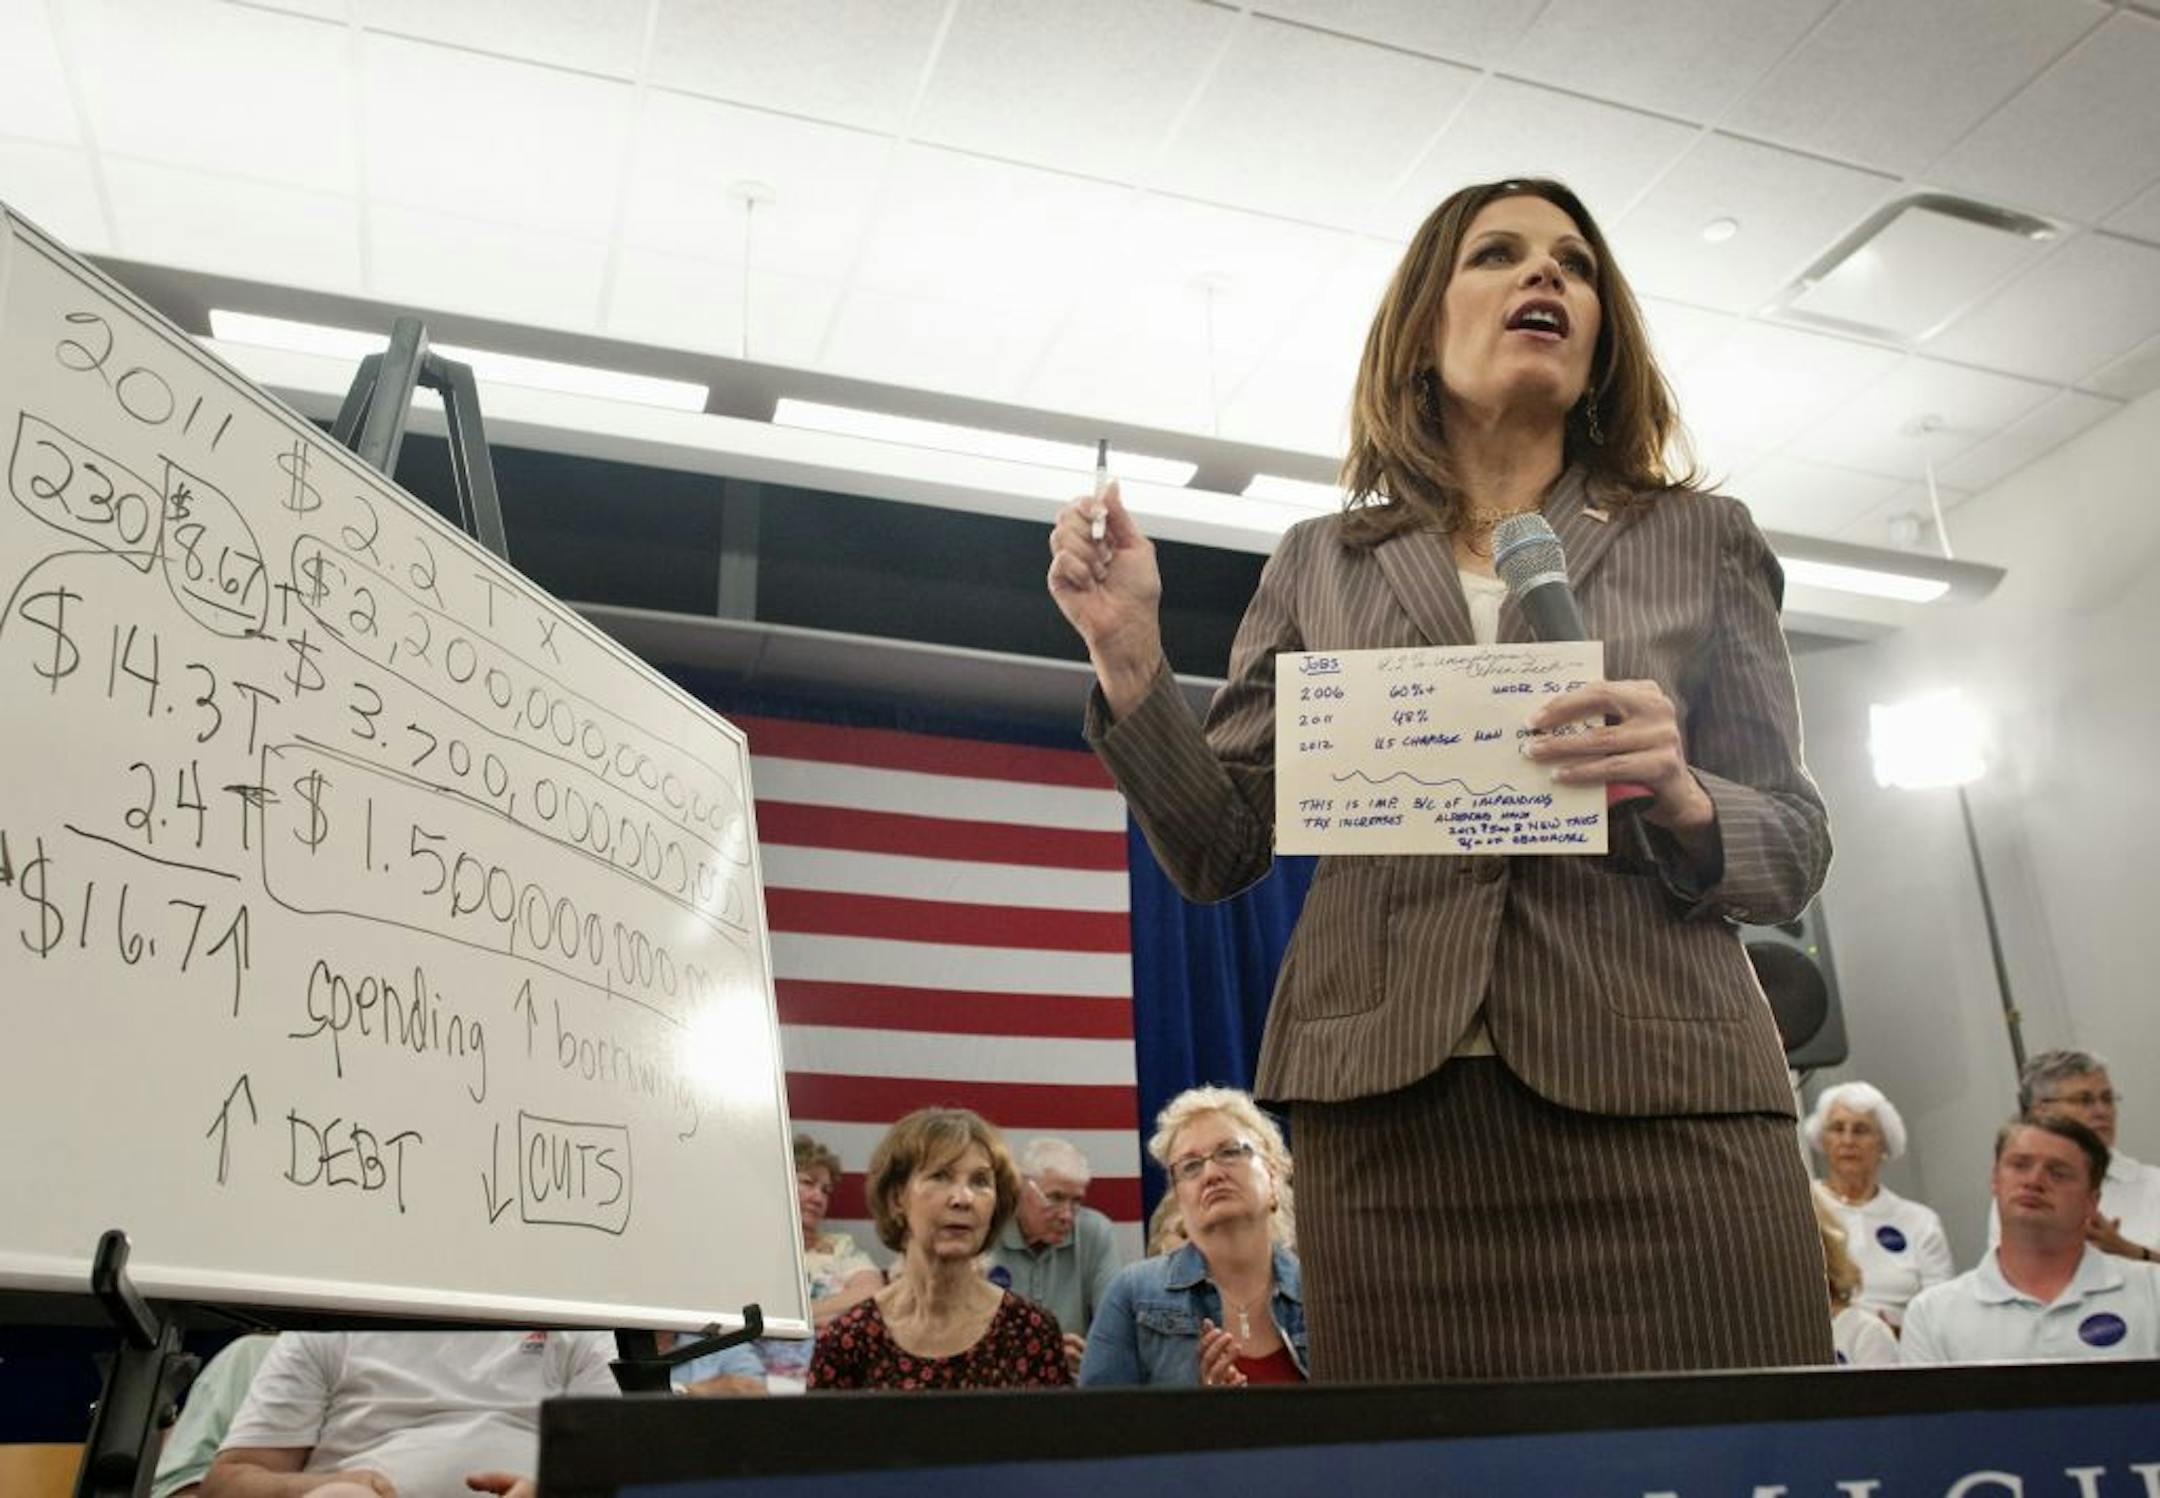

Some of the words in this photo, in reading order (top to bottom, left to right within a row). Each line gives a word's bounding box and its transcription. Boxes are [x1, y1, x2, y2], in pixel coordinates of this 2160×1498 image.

[55, 312, 233, 452] 2011
[30, 440, 149, 545] 230
[1299, 656, 1340, 672] JOBS
[1301, 686, 1344, 701] 2006
[1299, 714, 1334, 727] 2011
[1299, 799, 1334, 812] THIS
[283, 1107, 423, 1214] DEBT
[529, 1132, 624, 1206] CUTS
